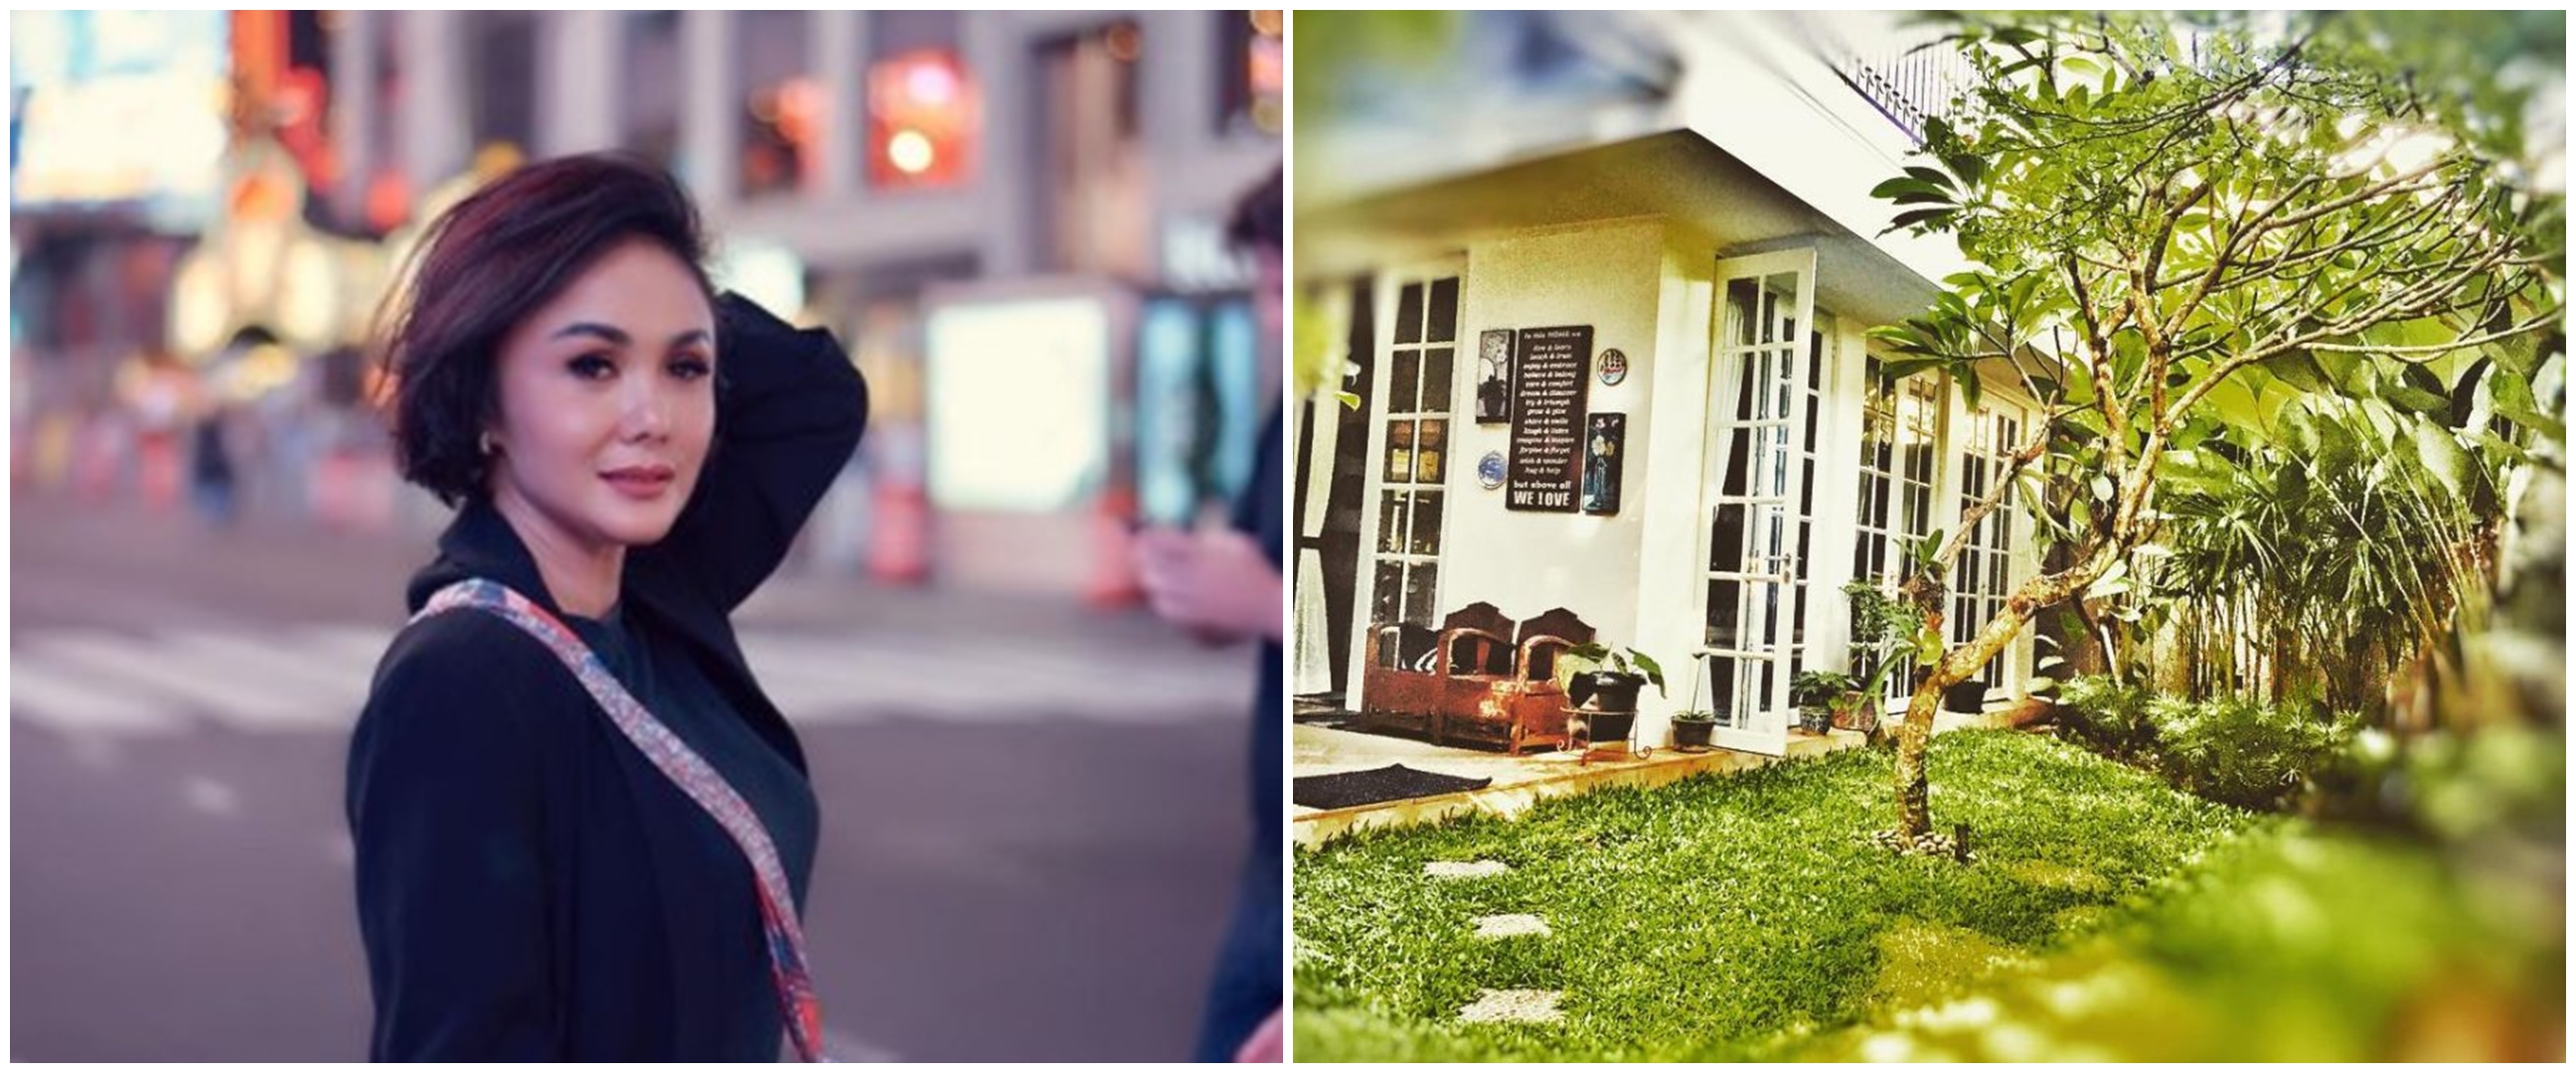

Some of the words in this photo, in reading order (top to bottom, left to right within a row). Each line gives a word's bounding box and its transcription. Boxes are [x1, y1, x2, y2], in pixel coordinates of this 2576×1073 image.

[1514, 479, 1529, 489] but
[1530, 479, 1556, 489] above
[1559, 480, 1571, 490] all
[1514, 490, 1534, 505] WE
